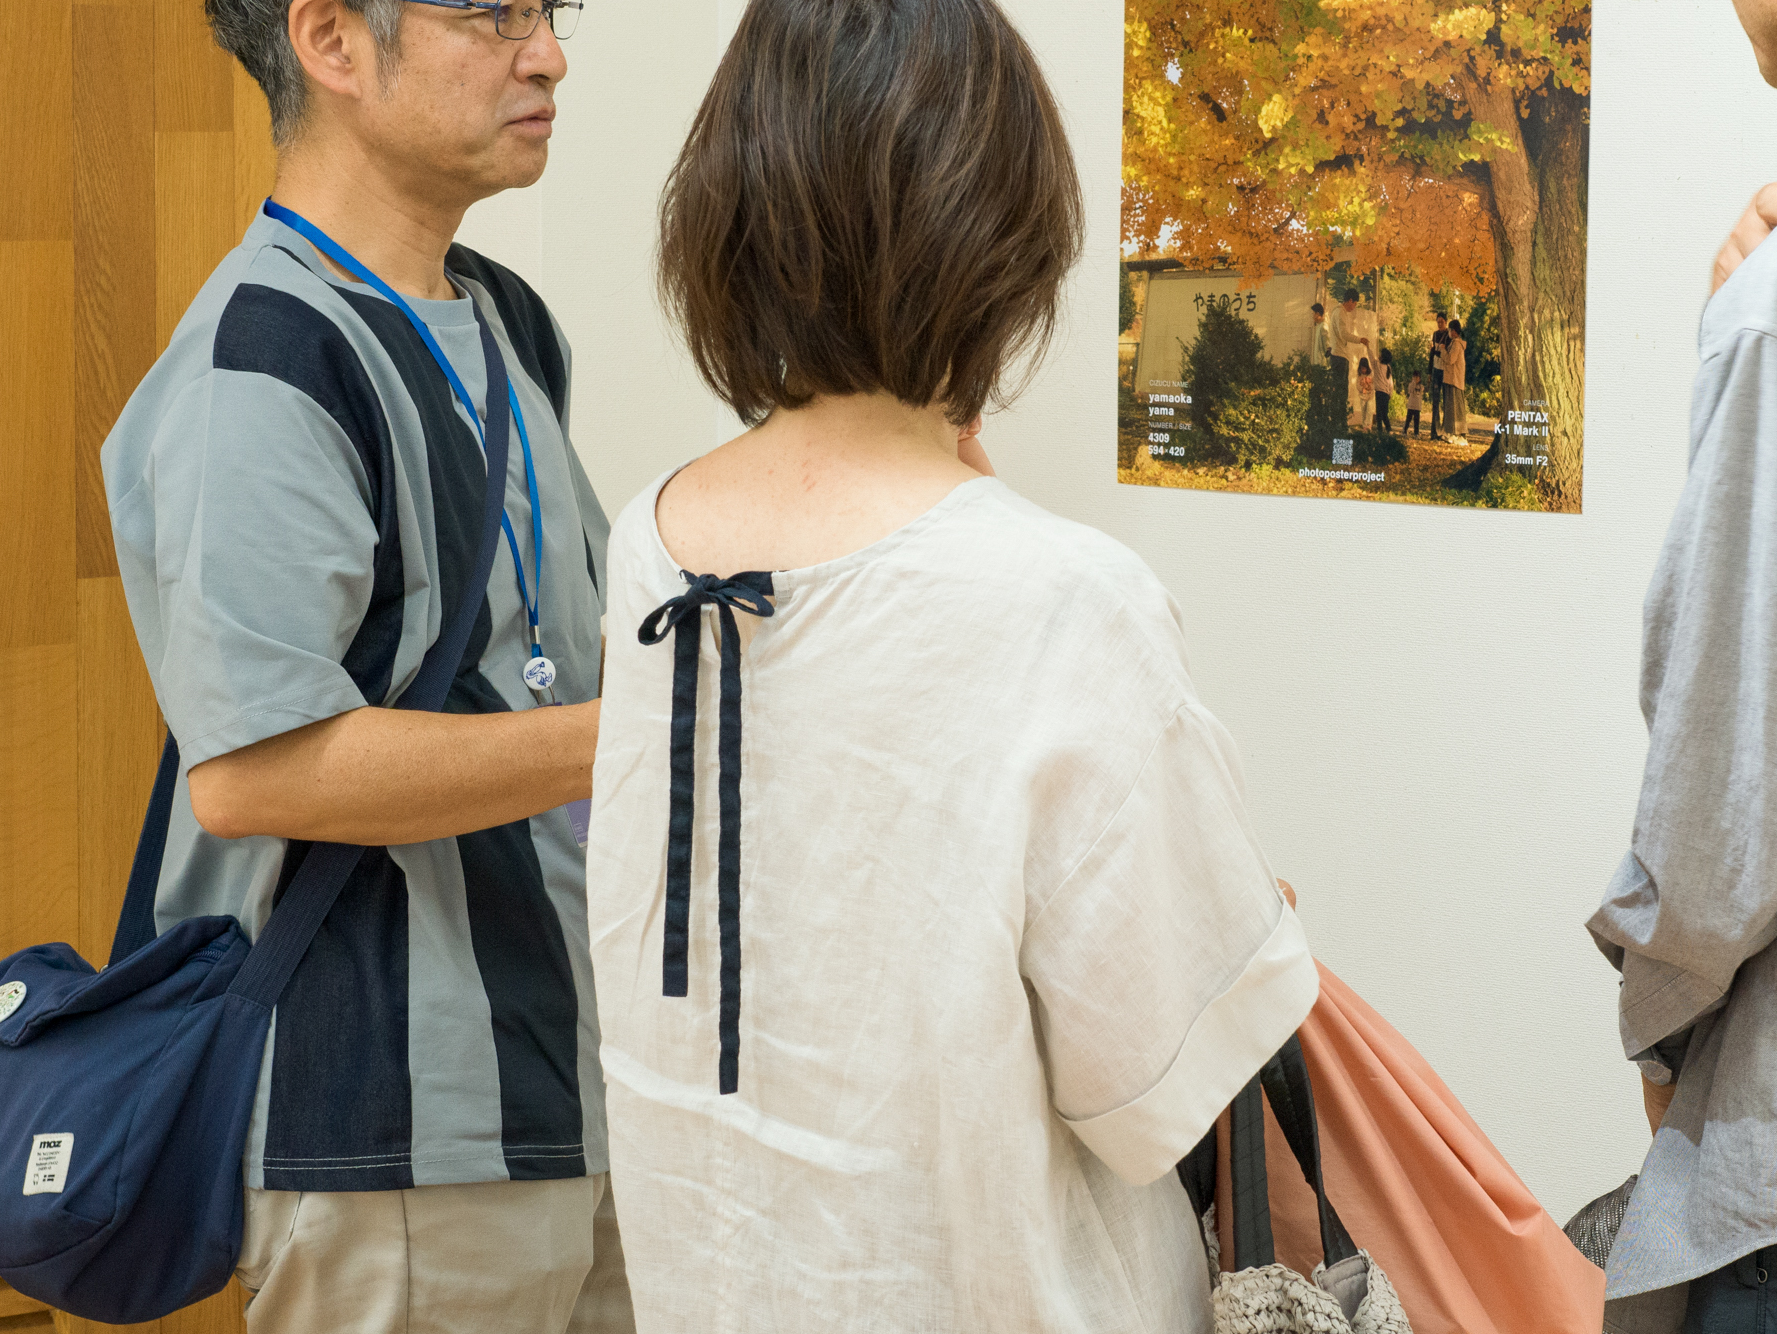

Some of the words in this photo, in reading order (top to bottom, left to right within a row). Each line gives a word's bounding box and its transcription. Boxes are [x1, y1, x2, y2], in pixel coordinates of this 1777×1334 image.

[1149, 379, 1171, 387] CIZUCU
[1148, 393, 1192, 404] yamaoka
[1148, 407, 1174, 416] yama
[1508, 410, 1549, 423] PENTAX
[1148, 421, 1173, 429] NUMBER
[1494, 423, 1510, 435] K-1
[1513, 424, 1539, 436] Mark
[1148, 432, 1170, 443] 4309
[1505, 453, 1534, 465] 35mm
[1536, 455, 1549, 466] F2
[1298, 467, 1385, 483] photoposterproject
